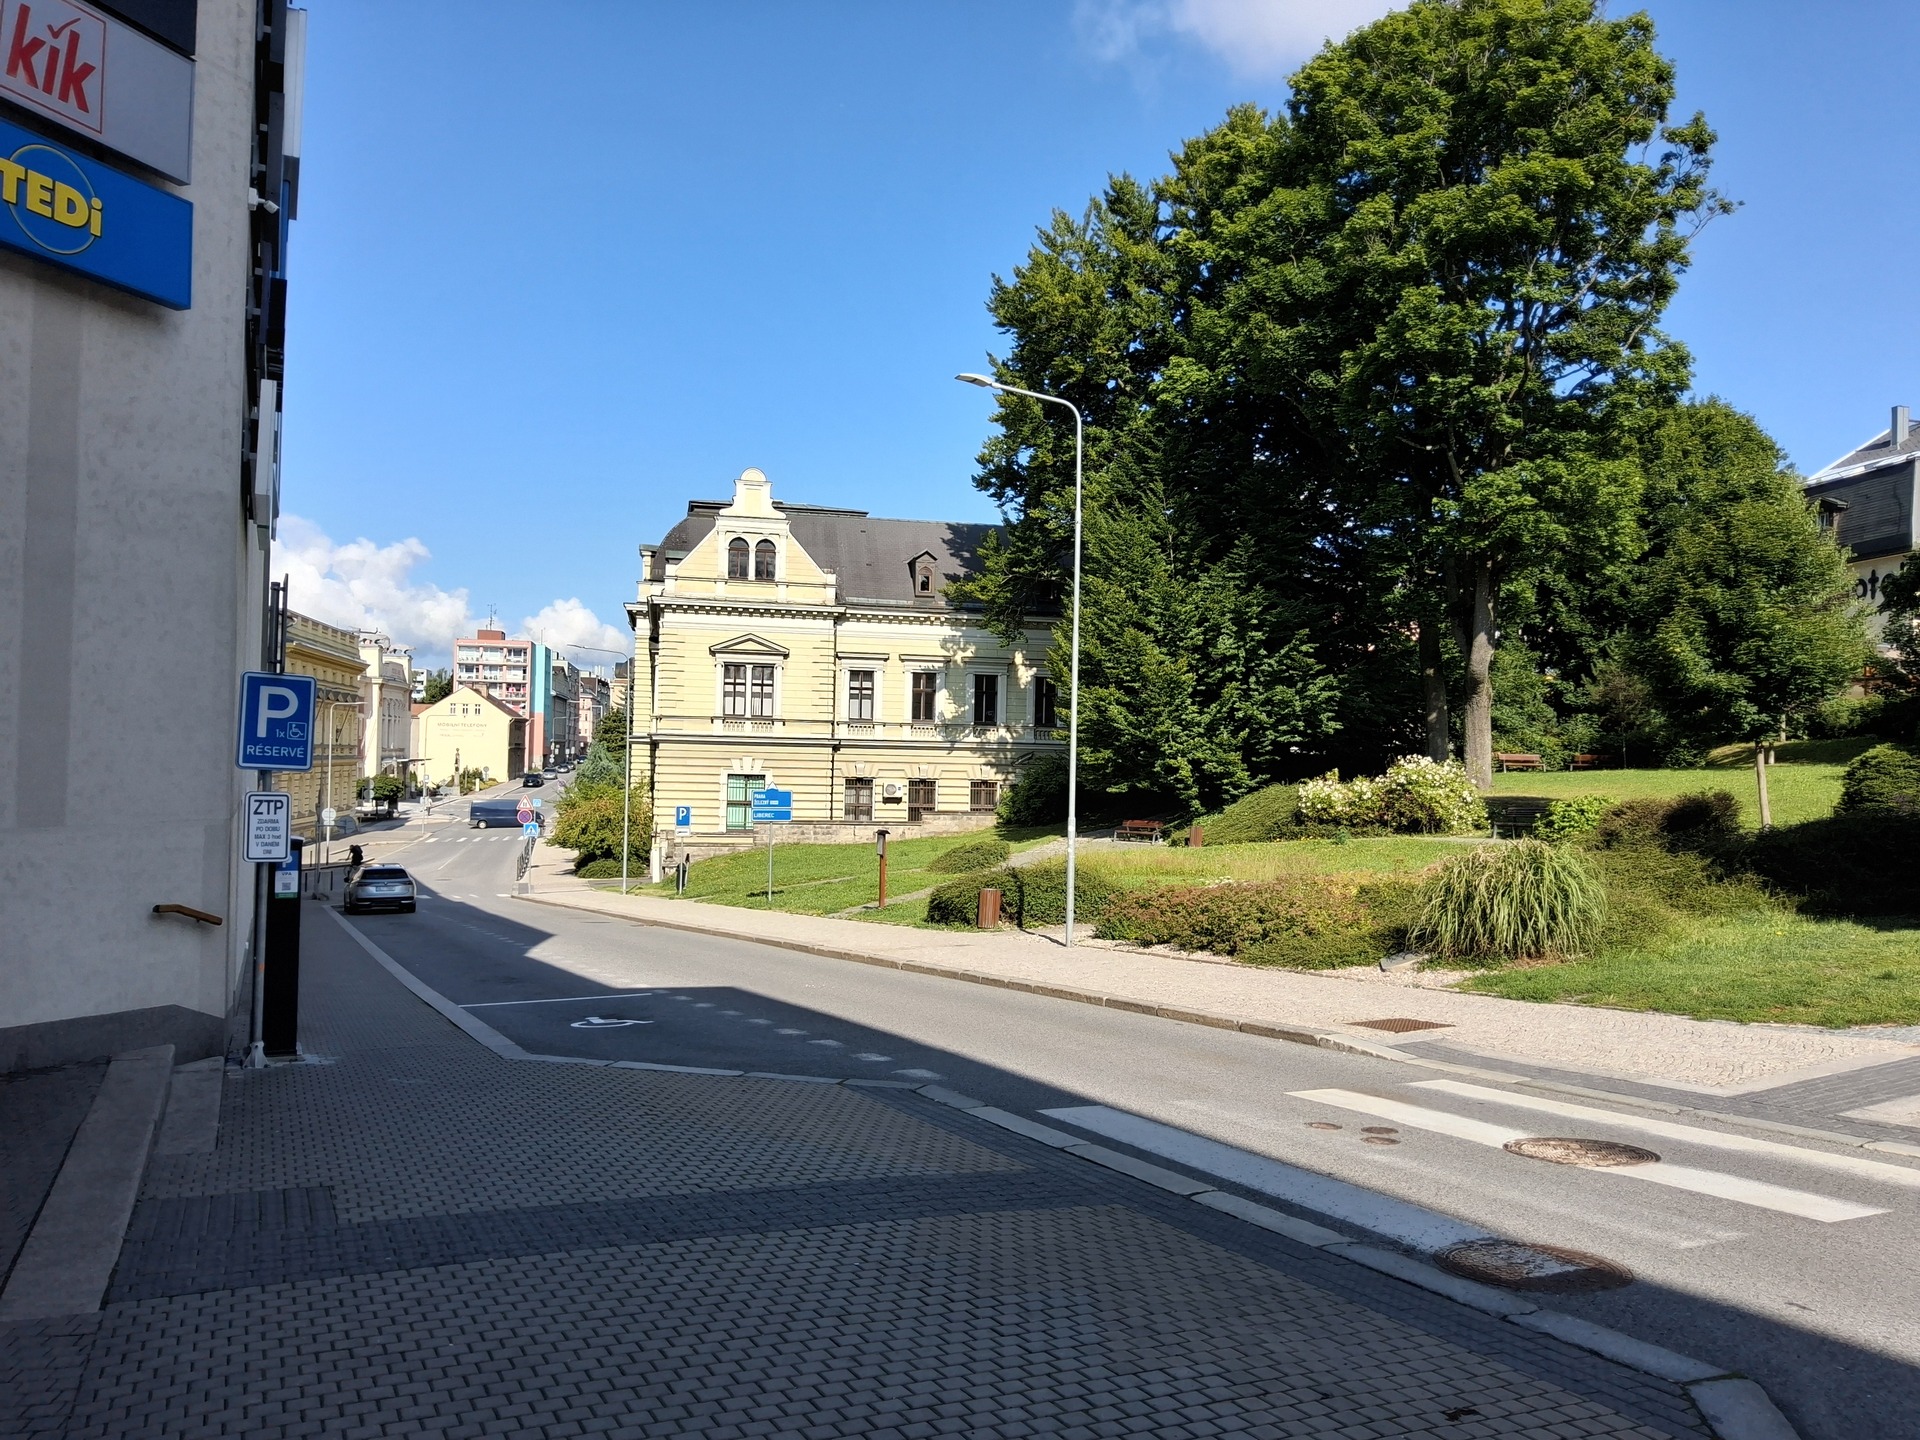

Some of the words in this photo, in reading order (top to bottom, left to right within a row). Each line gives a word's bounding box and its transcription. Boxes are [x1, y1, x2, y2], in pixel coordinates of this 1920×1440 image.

[0, 157, 103, 238] TEDi
[257, 685, 299, 738] P
[276, 728, 285, 738] 1x
[246, 744, 305, 758] RÉSERVÉ
[253, 799, 284, 815] ZTP
[679, 808, 687, 820] P
